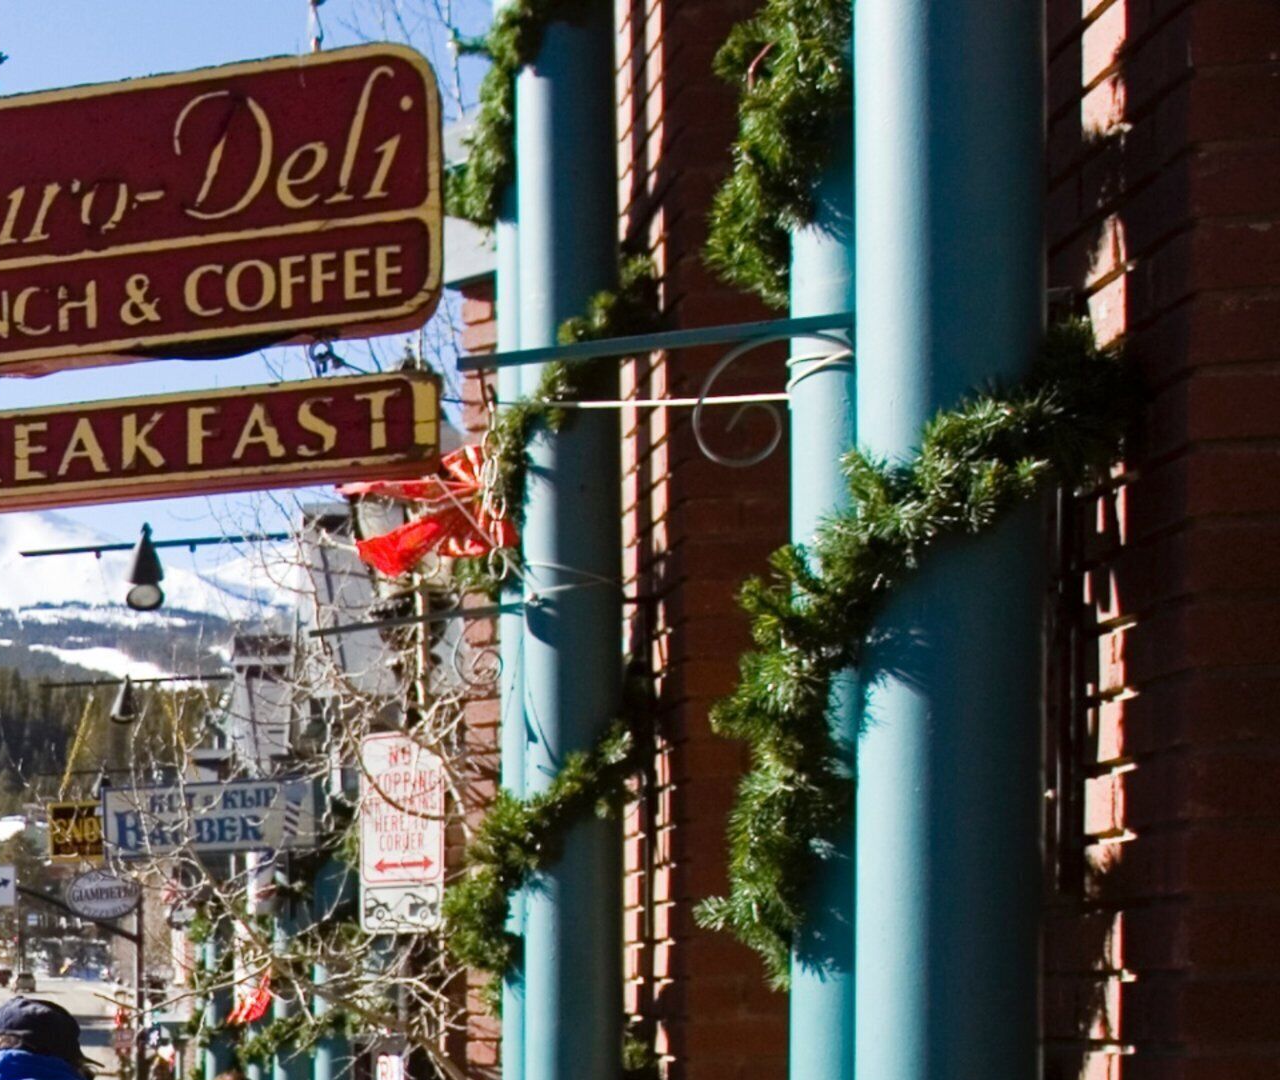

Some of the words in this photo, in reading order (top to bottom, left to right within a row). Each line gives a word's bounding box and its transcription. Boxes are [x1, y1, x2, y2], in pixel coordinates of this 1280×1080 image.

[120, 274, 161, 325] &
[183, 245, 403, 317] COFFEE
[388, 745, 411, 767] NO
[53, 816, 103, 844] SNO
[375, 815, 406, 833] HERE
[379, 833, 424, 852] CORNER
